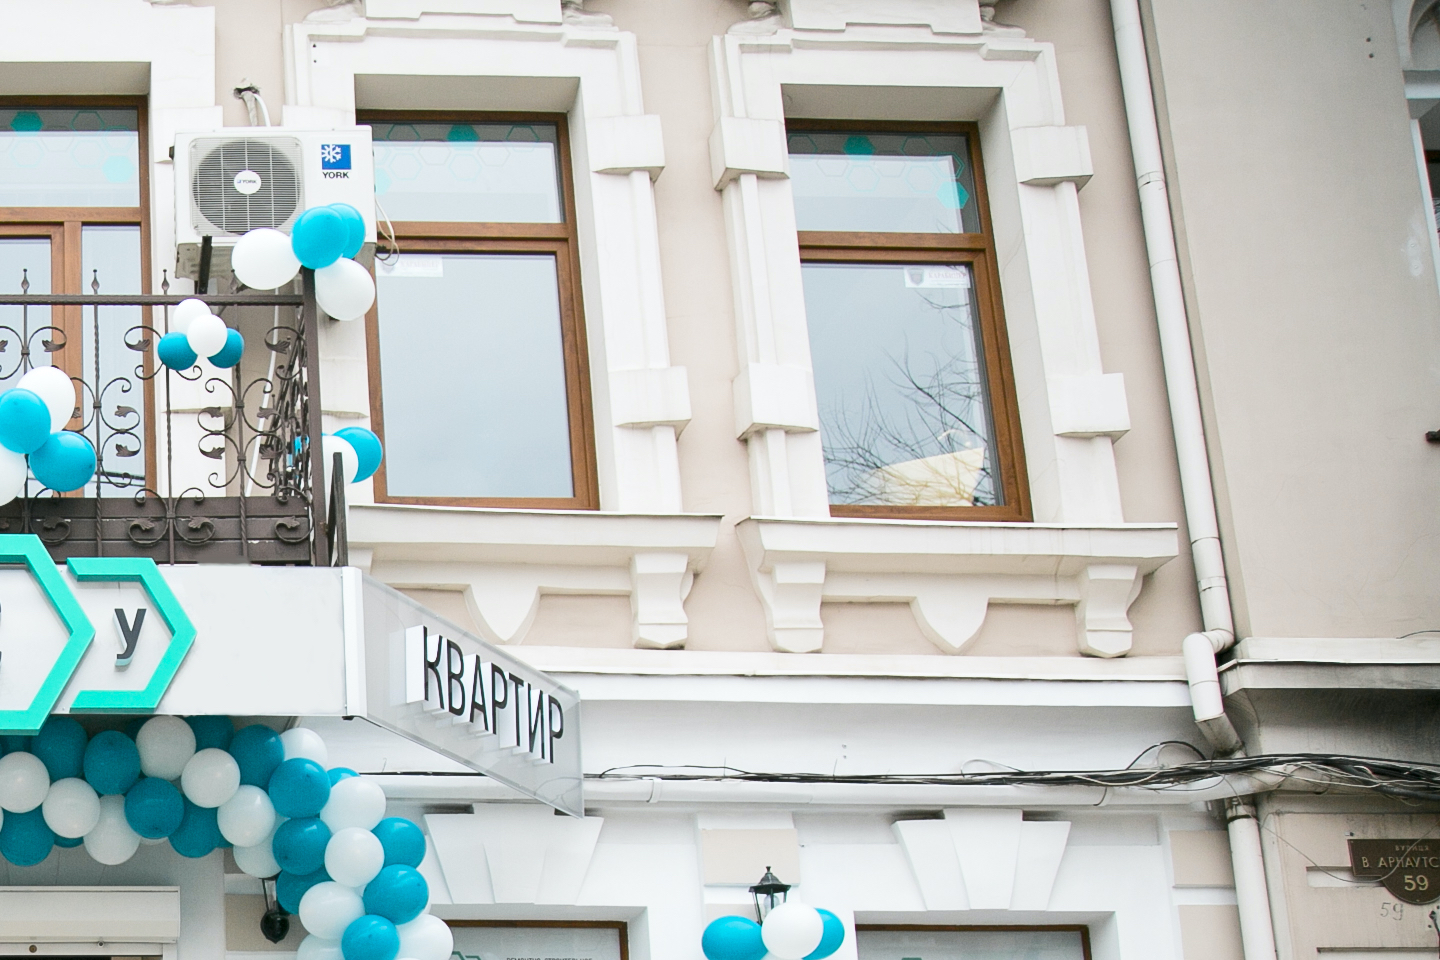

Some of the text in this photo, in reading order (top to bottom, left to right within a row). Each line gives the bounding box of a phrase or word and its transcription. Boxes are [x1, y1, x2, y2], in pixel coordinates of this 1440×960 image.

[322, 171, 350, 179] YORK
[422, 624, 565, 764] КВАРТИР
[1404, 874, 1429, 891] 59
